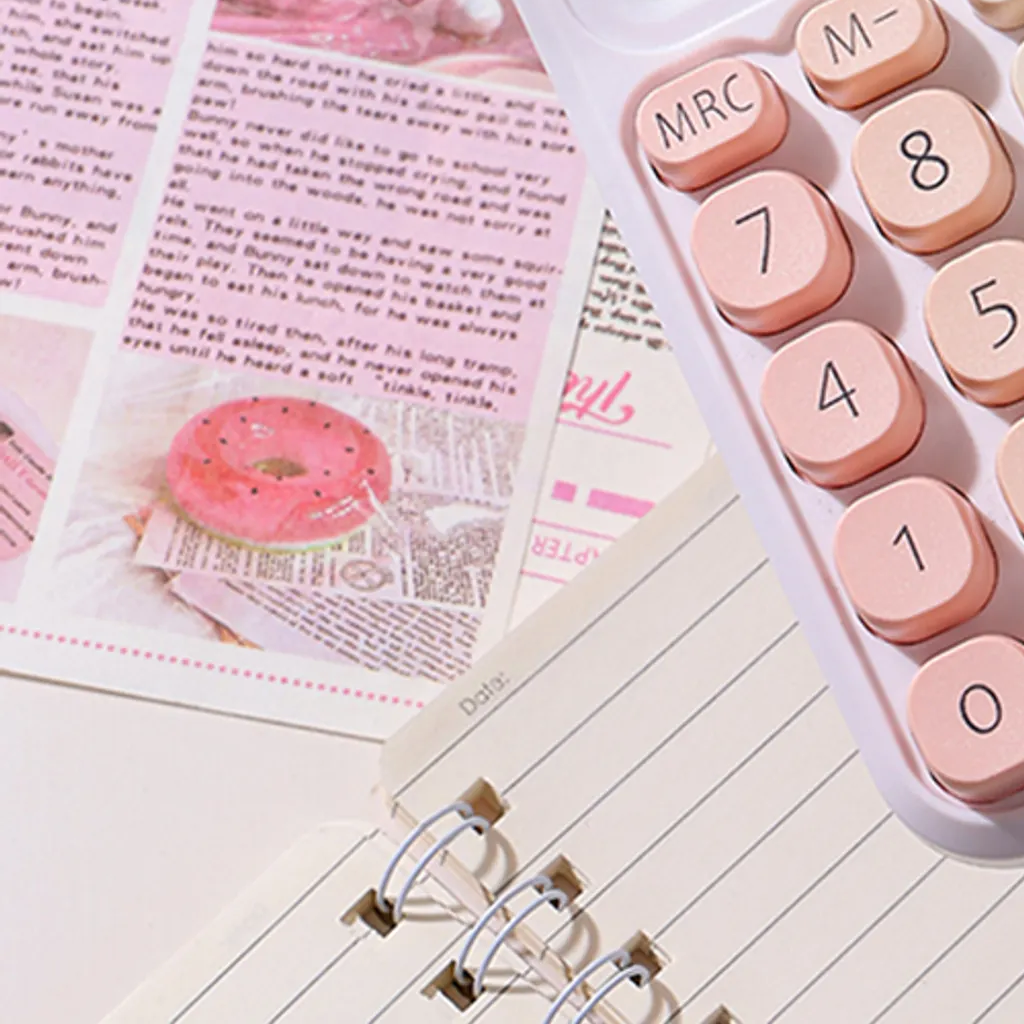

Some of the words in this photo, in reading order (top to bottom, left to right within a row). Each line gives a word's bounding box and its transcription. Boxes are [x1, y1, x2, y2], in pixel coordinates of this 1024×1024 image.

[202, 60, 249, 76] down
[256, 70, 283, 84] the
[290, 76, 329, 92] road
[336, 86, 376, 100] with
[382, 92, 408, 108] his
[416, 100, 469, 117] dinner
[542, 121, 568, 136] his
[206, 41, 238, 56] him
[272, 54, 310, 70] hard
[317, 63, 351, 78] that
[384, 78, 430, 94] cried
[505, 100, 536, 112] and
[653, 73, 756, 150] MRC
[187, 108, 238, 130] Bunny
[246, 122, 292, 137] never
[300, 130, 329, 145] did
[334, 136, 365, 152] like
[452, 160, 508, 177] school
[515, 172, 550, 186] very
[197, 78, 232, 93] arm,
[240, 84, 314, 108] brushing
[322, 99, 348, 113] the
[356, 106, 398, 123] tears
[406, 117, 450, 134] away
[460, 128, 499, 140] with
[506, 132, 532, 147] his
[178, 144, 212, 160] that
[246, 156, 279, 172] had
[285, 163, 331, 180] taken
[338, 173, 365, 188] the
[374, 182, 426, 201] wrong
[433, 192, 472, 208] road
[479, 200, 510, 214] and
[517, 208, 551, 220] was
[259, 142, 304, 157] when
[338, 156, 407, 178] stopped
[480, 183, 511, 196] and
[518, 187, 566, 206] found
[900, 129, 949, 191] 8
[173, 163, 221, 180] going
[229, 172, 264, 186] into
[272, 178, 298, 193] the
[405, 206, 439, 219] was
[446, 212, 474, 225] not
[482, 219, 526, 235] sorry
[194, 203, 236, 218] went
[288, 217, 329, 235] little
[338, 230, 372, 244] way
[380, 236, 412, 250] and
[418, 244, 453, 257] saw
[153, 230, 196, 248] time,
[206, 240, 238, 255] and
[243, 244, 295, 267] Bunny
[337, 263, 386, 280] down
[420, 280, 472, 296] watch
[480, 288, 521, 304] them
[205, 218, 244, 239] They
[252, 230, 317, 252] seemed
[375, 252, 434, 274] having
[460, 270, 496, 284] very
[504, 276, 547, 292] good
[735, 205, 772, 275] 7
[142, 262, 194, 282] began
[227, 281, 254, 294] eat
[260, 285, 288, 301] his
[296, 292, 344, 312] lunch,
[355, 302, 380, 316] for
[416, 316, 450, 329] was
[458, 321, 518, 340] always
[148, 248, 189, 262] their
[248, 263, 288, 282] Then
[322, 280, 386, 300] opened
[391, 290, 418, 306] his
[424, 296, 482, 316] basket
[490, 310, 522, 323] and
[969, 278, 1019, 350] 5
[122, 336, 162, 351] eyes
[169, 344, 211, 358] until
[243, 354, 294, 375] heard
[318, 371, 353, 385] soft
[128, 317, 163, 333] that
[199, 328, 225, 344] fell
[299, 350, 332, 363] and
[364, 360, 412, 376] never
[420, 371, 484, 390] opened
[488, 380, 516, 396] his
[164, 306, 198, 320] was
[236, 318, 278, 336] tired
[285, 328, 326, 346] then,
[336, 336, 378, 352] after
[384, 344, 412, 359] his
[420, 350, 456, 368] long
[817, 360, 860, 418] 4
[530, 534, 599, 566] PTER
[891, 524, 926, 573] 1
[958, 683, 1003, 735] 0
